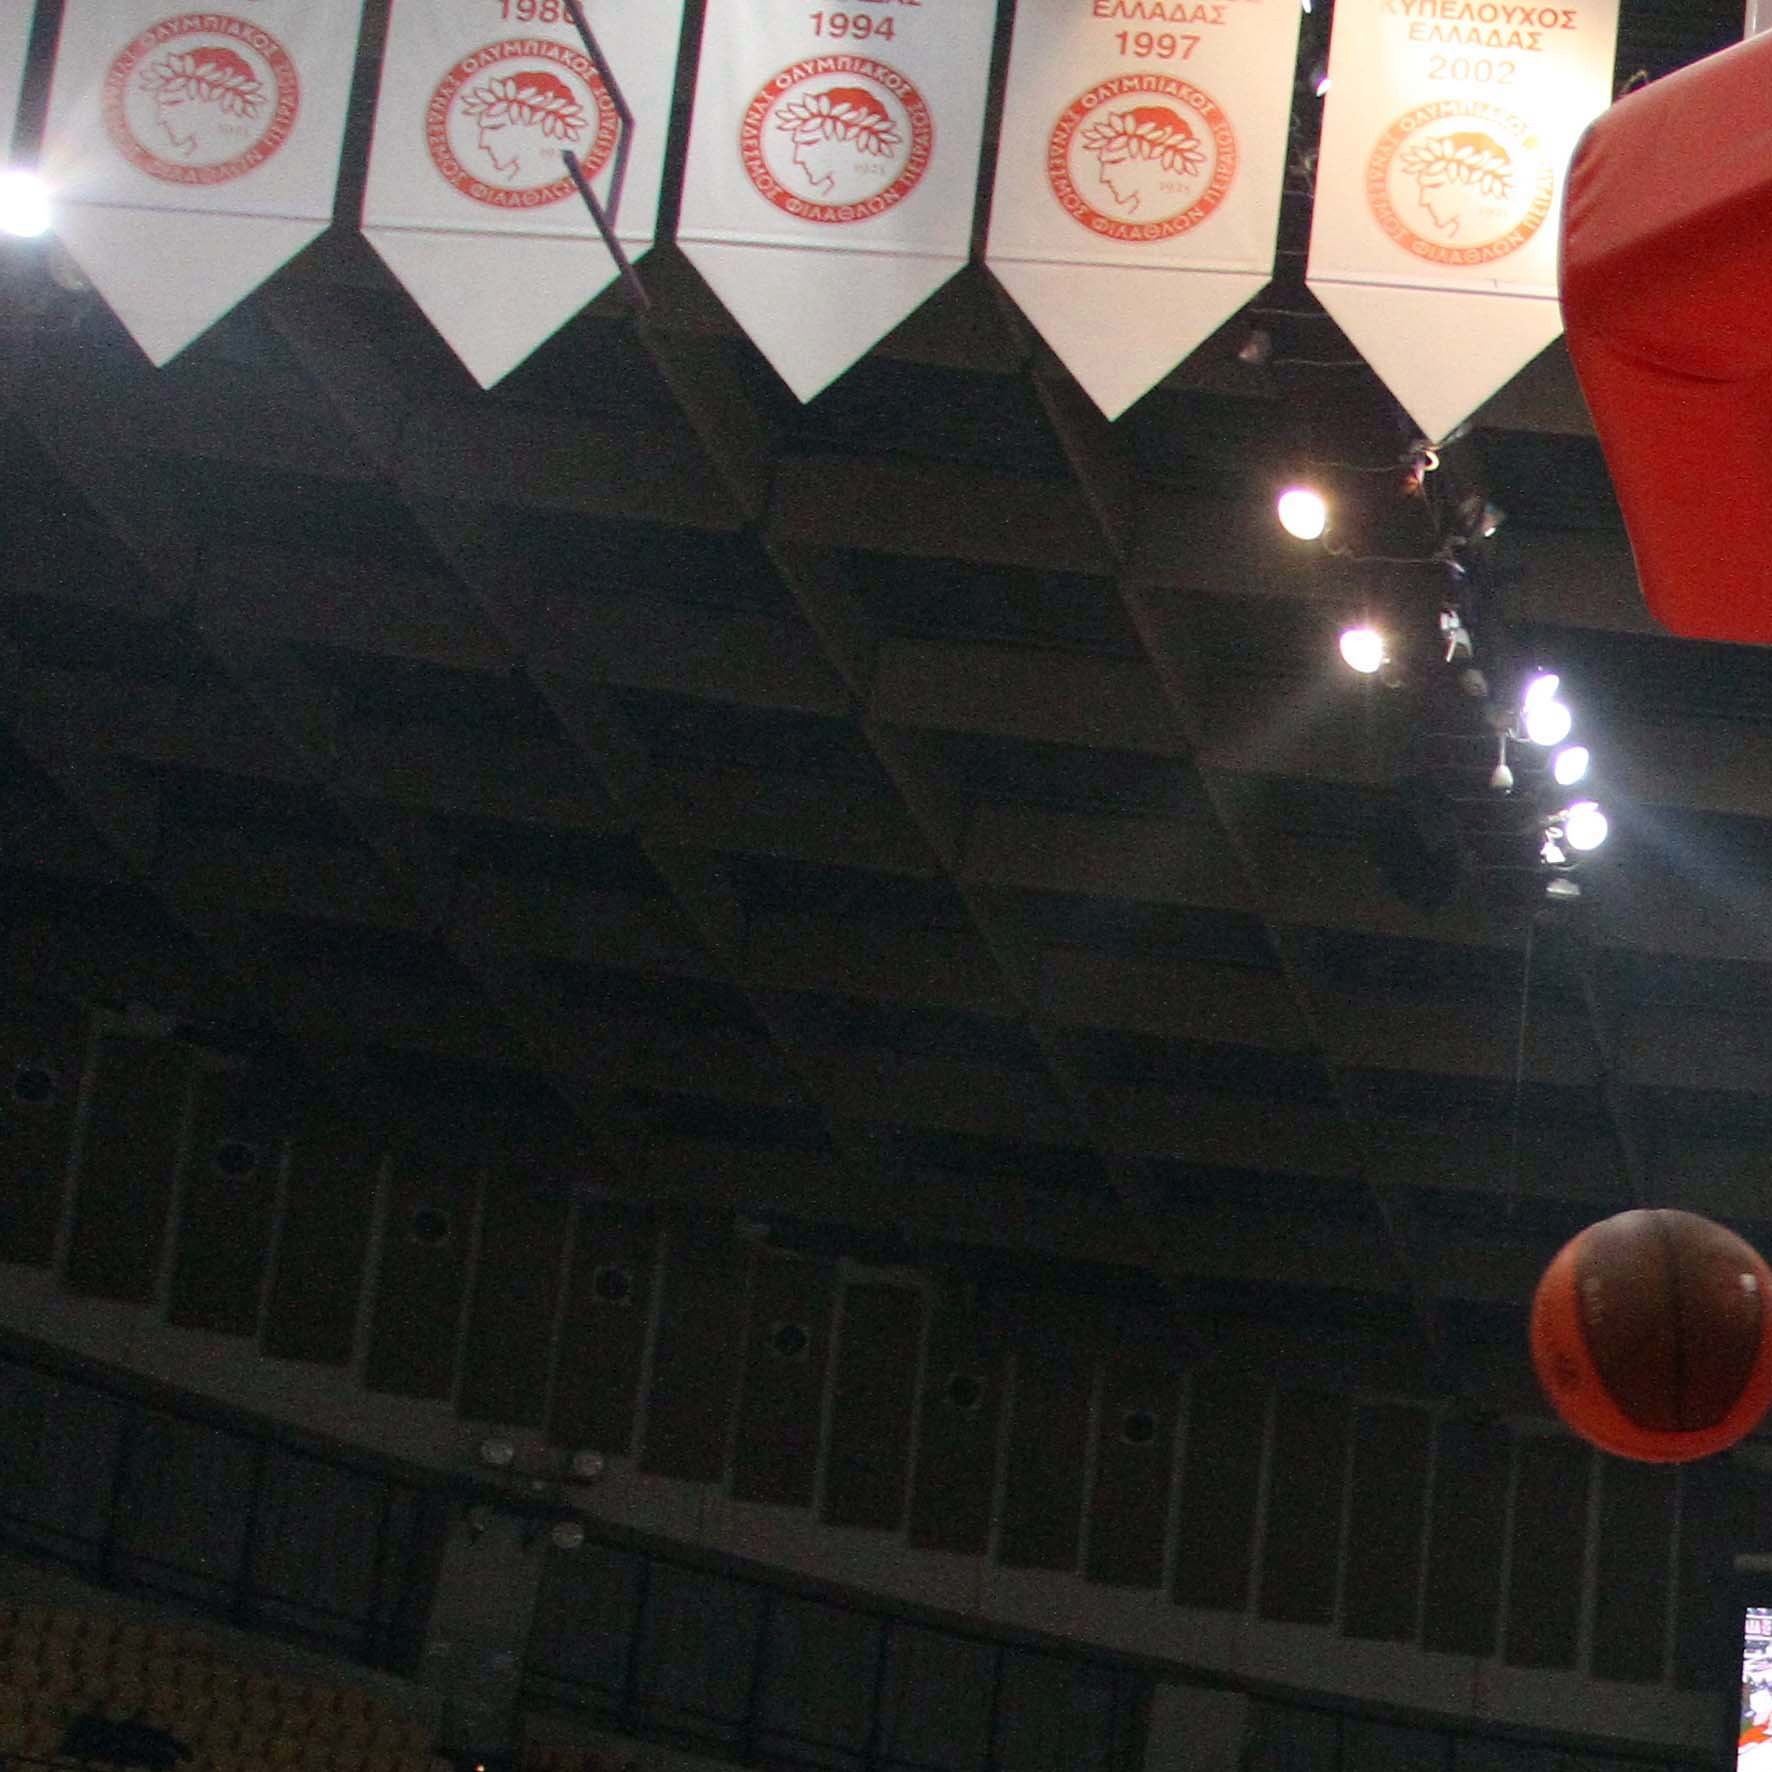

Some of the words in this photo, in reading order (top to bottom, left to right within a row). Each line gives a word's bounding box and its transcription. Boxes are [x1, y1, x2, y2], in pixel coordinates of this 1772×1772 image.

[810, 10, 896, 41] 1994
[1092, 0, 1228, 25] ΕΛΛΑΔΑΣ
[1115, 30, 1202, 60] 1997
[1409, 21, 1545, 51] ΕΛΛΑΔΑΣ
[776, 57, 912, 98] ΟΛΥΜΠΙΑΚΟΣ
[1428, 55, 1517, 86] 2002
[1082, 76, 1217, 114] ΟΛΥΜΠΙΑΚΟΣ
